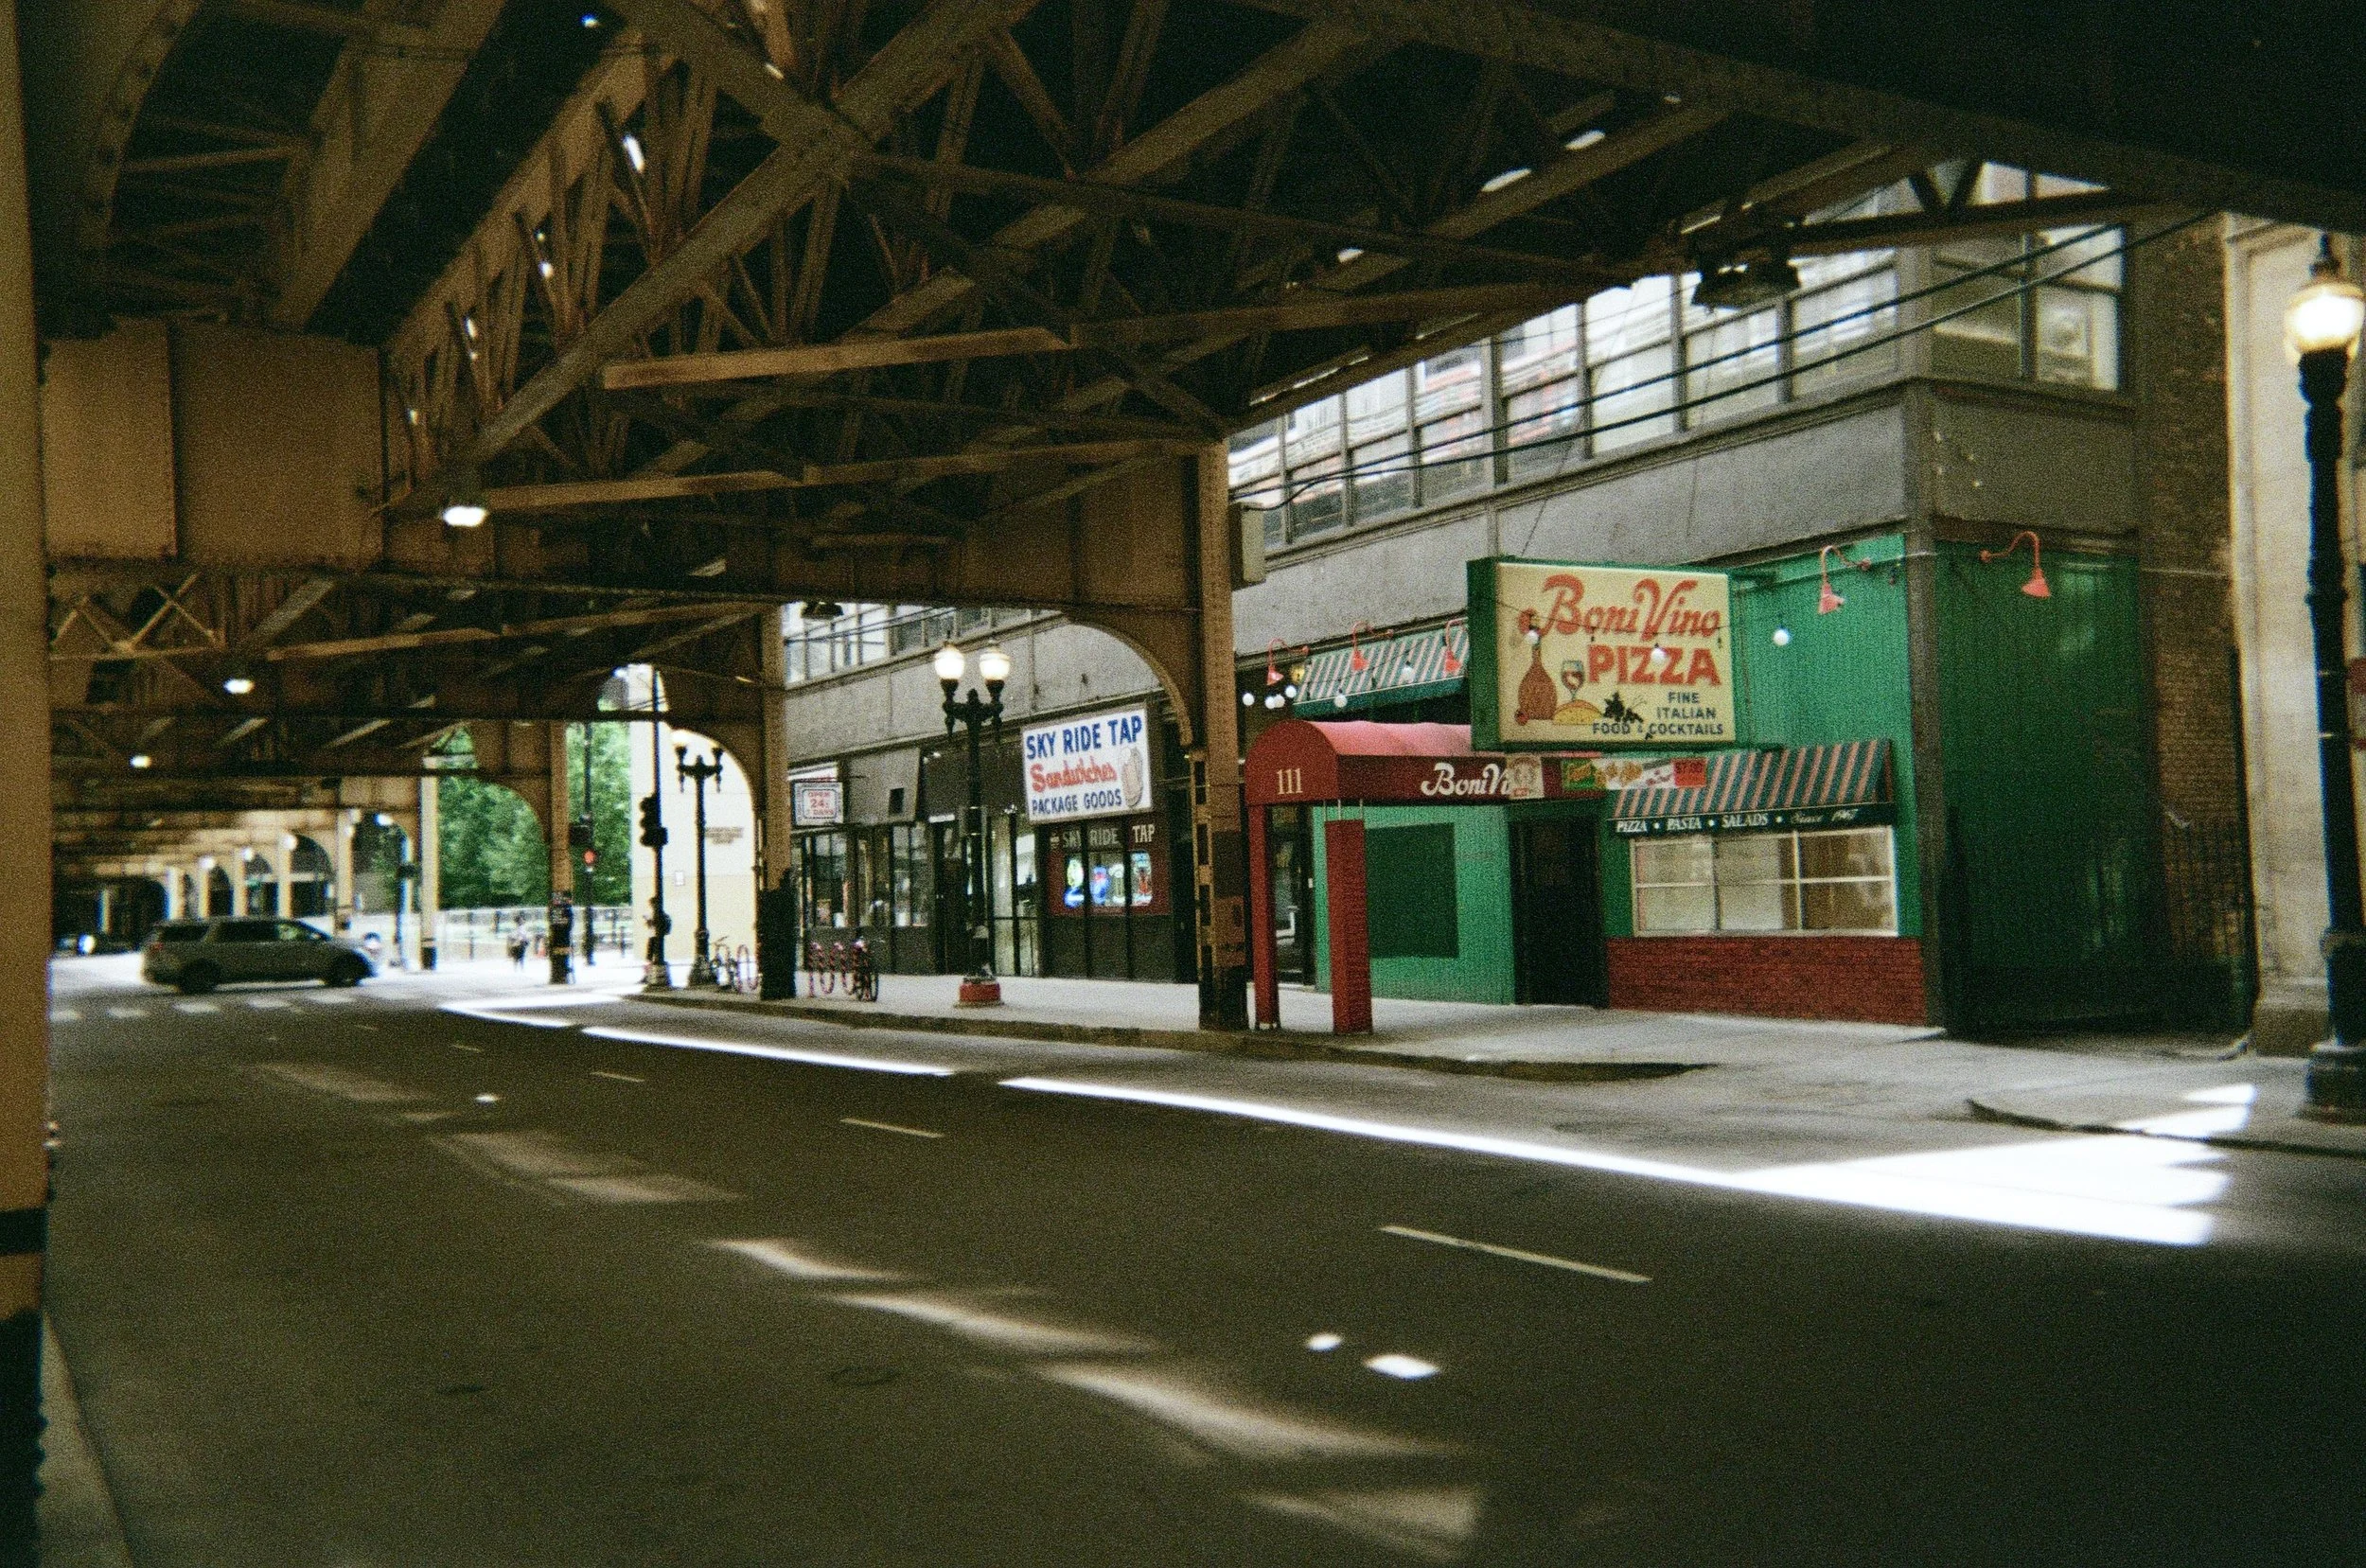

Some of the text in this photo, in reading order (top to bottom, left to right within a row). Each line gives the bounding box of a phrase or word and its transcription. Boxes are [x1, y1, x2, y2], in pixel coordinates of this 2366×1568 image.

[1518, 573, 1721, 641] Boni Vino
[1587, 645, 1721, 685] PIZZA
[1668, 692, 1701, 704] FINE
[1656, 706, 1717, 720] ITALIAN
[1026, 715, 1142, 760] SKY RIDE TAP
[1592, 722, 1631, 735] FOOD
[1649, 722, 1724, 735] COCKTAILS
[1277, 767, 1303, 795] 111
[1421, 762, 1487, 796] Boni
[1032, 788, 1122, 815] PACKAGE GOODS
[1089, 828, 1119, 846] RIDE
[1132, 824, 1156, 843] TAP
[1616, 820, 1648, 833] PIZZA
[1667, 818, 1703, 831] PASTA
[1722, 812, 1769, 828] SALADS
